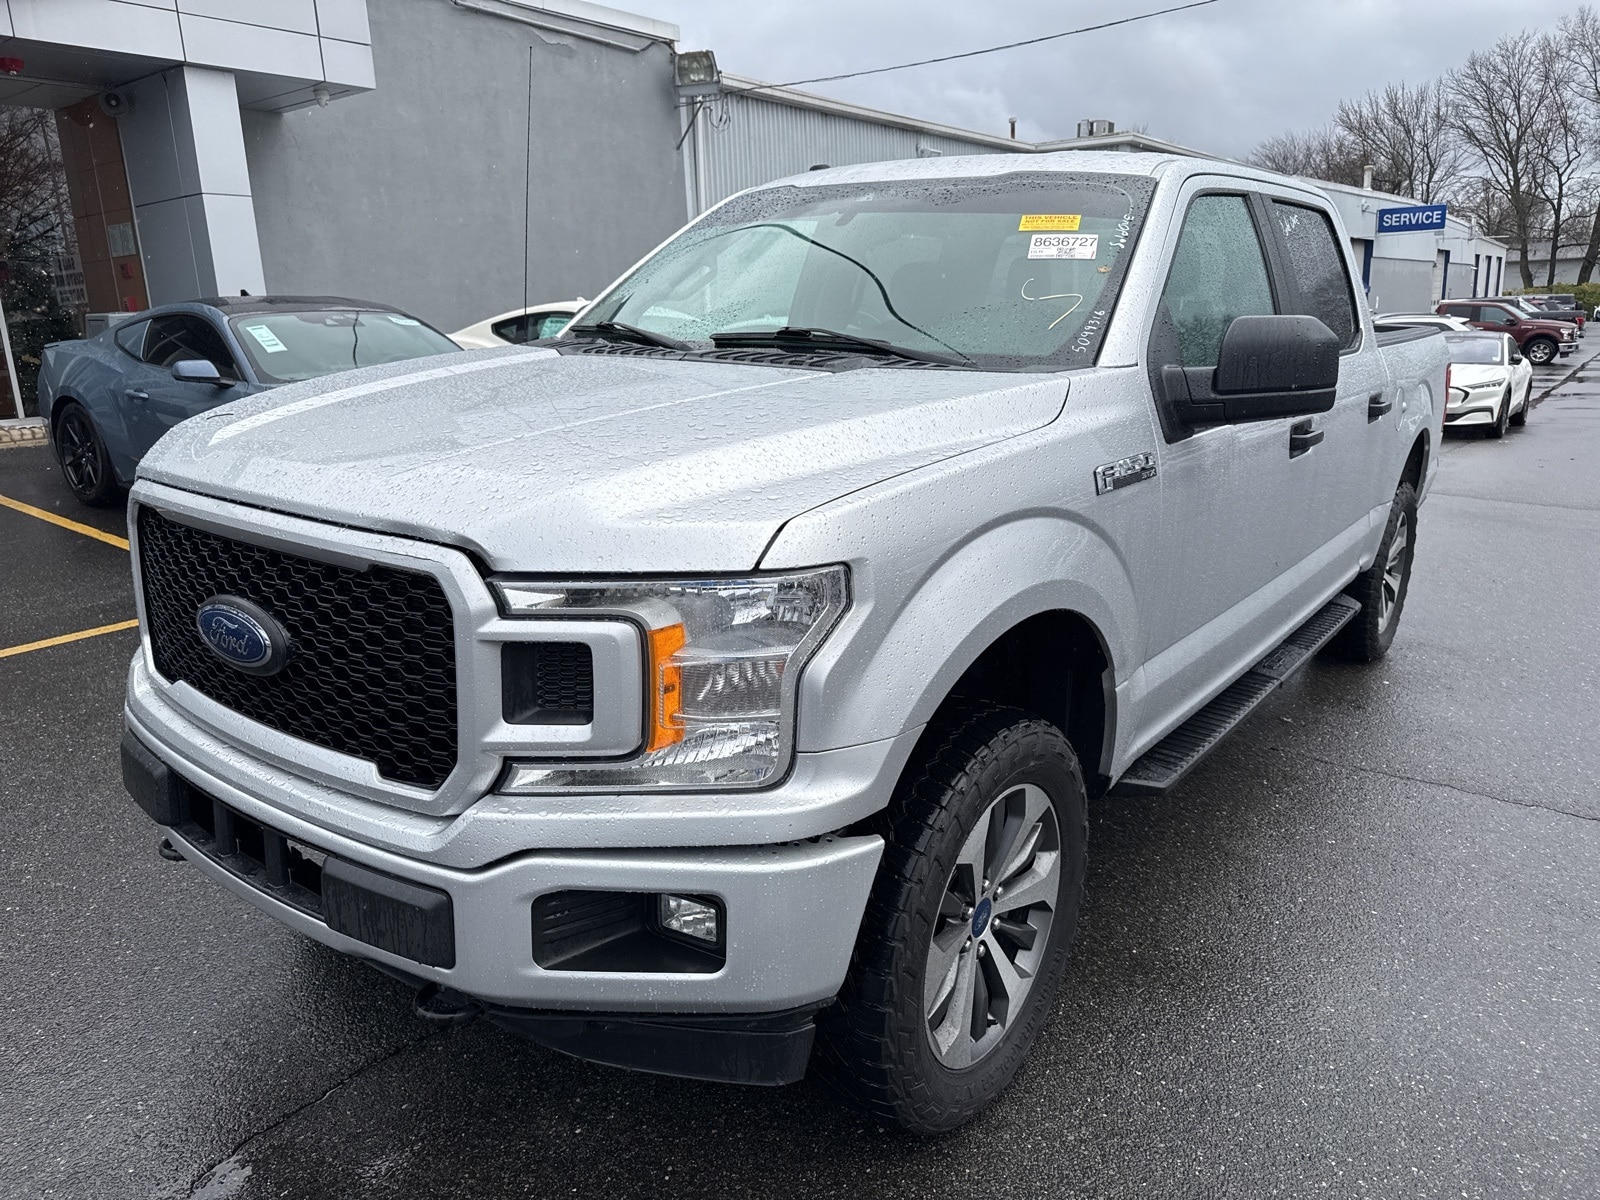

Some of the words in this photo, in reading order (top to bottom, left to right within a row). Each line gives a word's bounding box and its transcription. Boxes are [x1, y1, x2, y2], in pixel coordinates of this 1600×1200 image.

[1382, 211, 1442, 227] SERVICE
[1034, 237, 1097, 247] 8636727
[1071, 309, 1105, 353] 5099316
[209, 616, 249, 656] Ford
